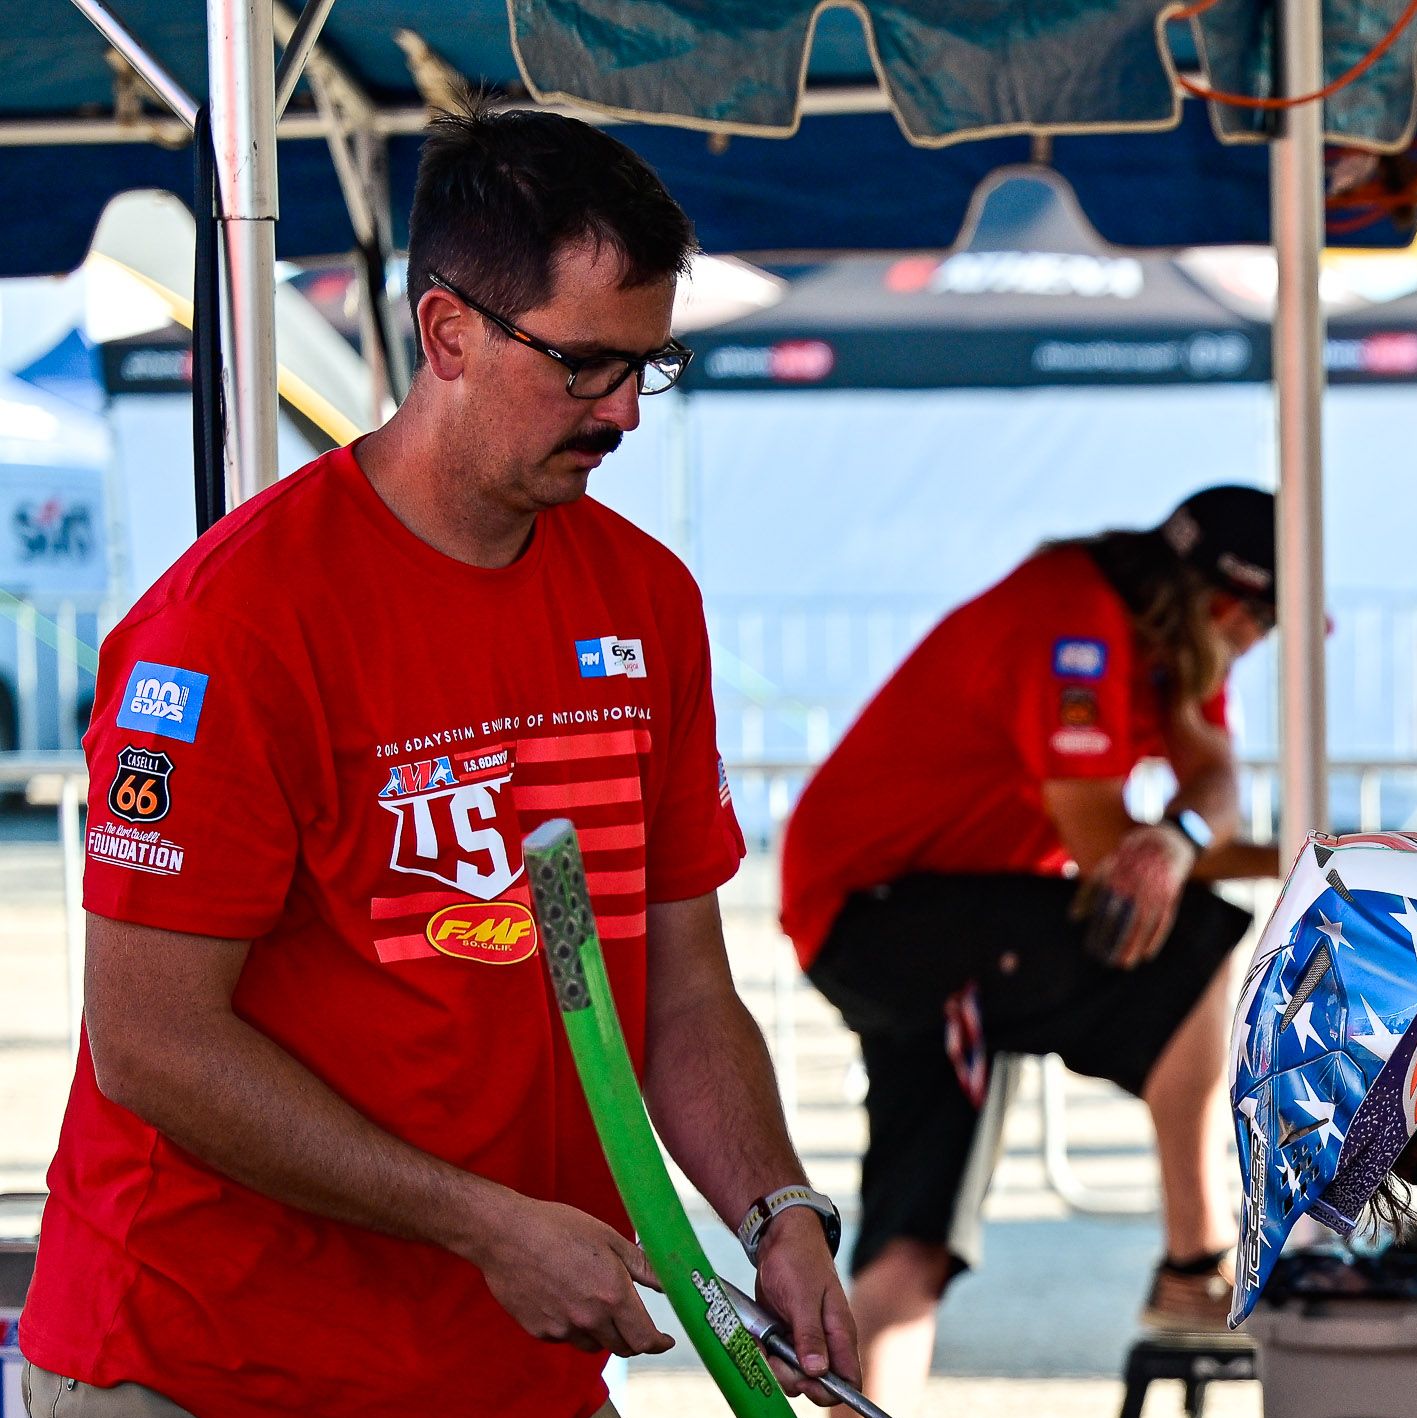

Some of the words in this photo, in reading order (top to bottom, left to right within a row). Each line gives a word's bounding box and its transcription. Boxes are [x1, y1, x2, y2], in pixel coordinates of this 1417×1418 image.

[130, 696, 184, 723] 6DAYS
[405, 730, 451, 753] 6DAYS
[453, 727, 475, 742] FIM
[526, 713, 545, 728] OF
[127, 753, 159, 771] CASELLI
[377, 755, 460, 798] AMA
[116, 774, 158, 815] 66
[104, 821, 116, 835] The
[88, 831, 184, 872] FOUNDATION
[435, 917, 532, 945] FMF
